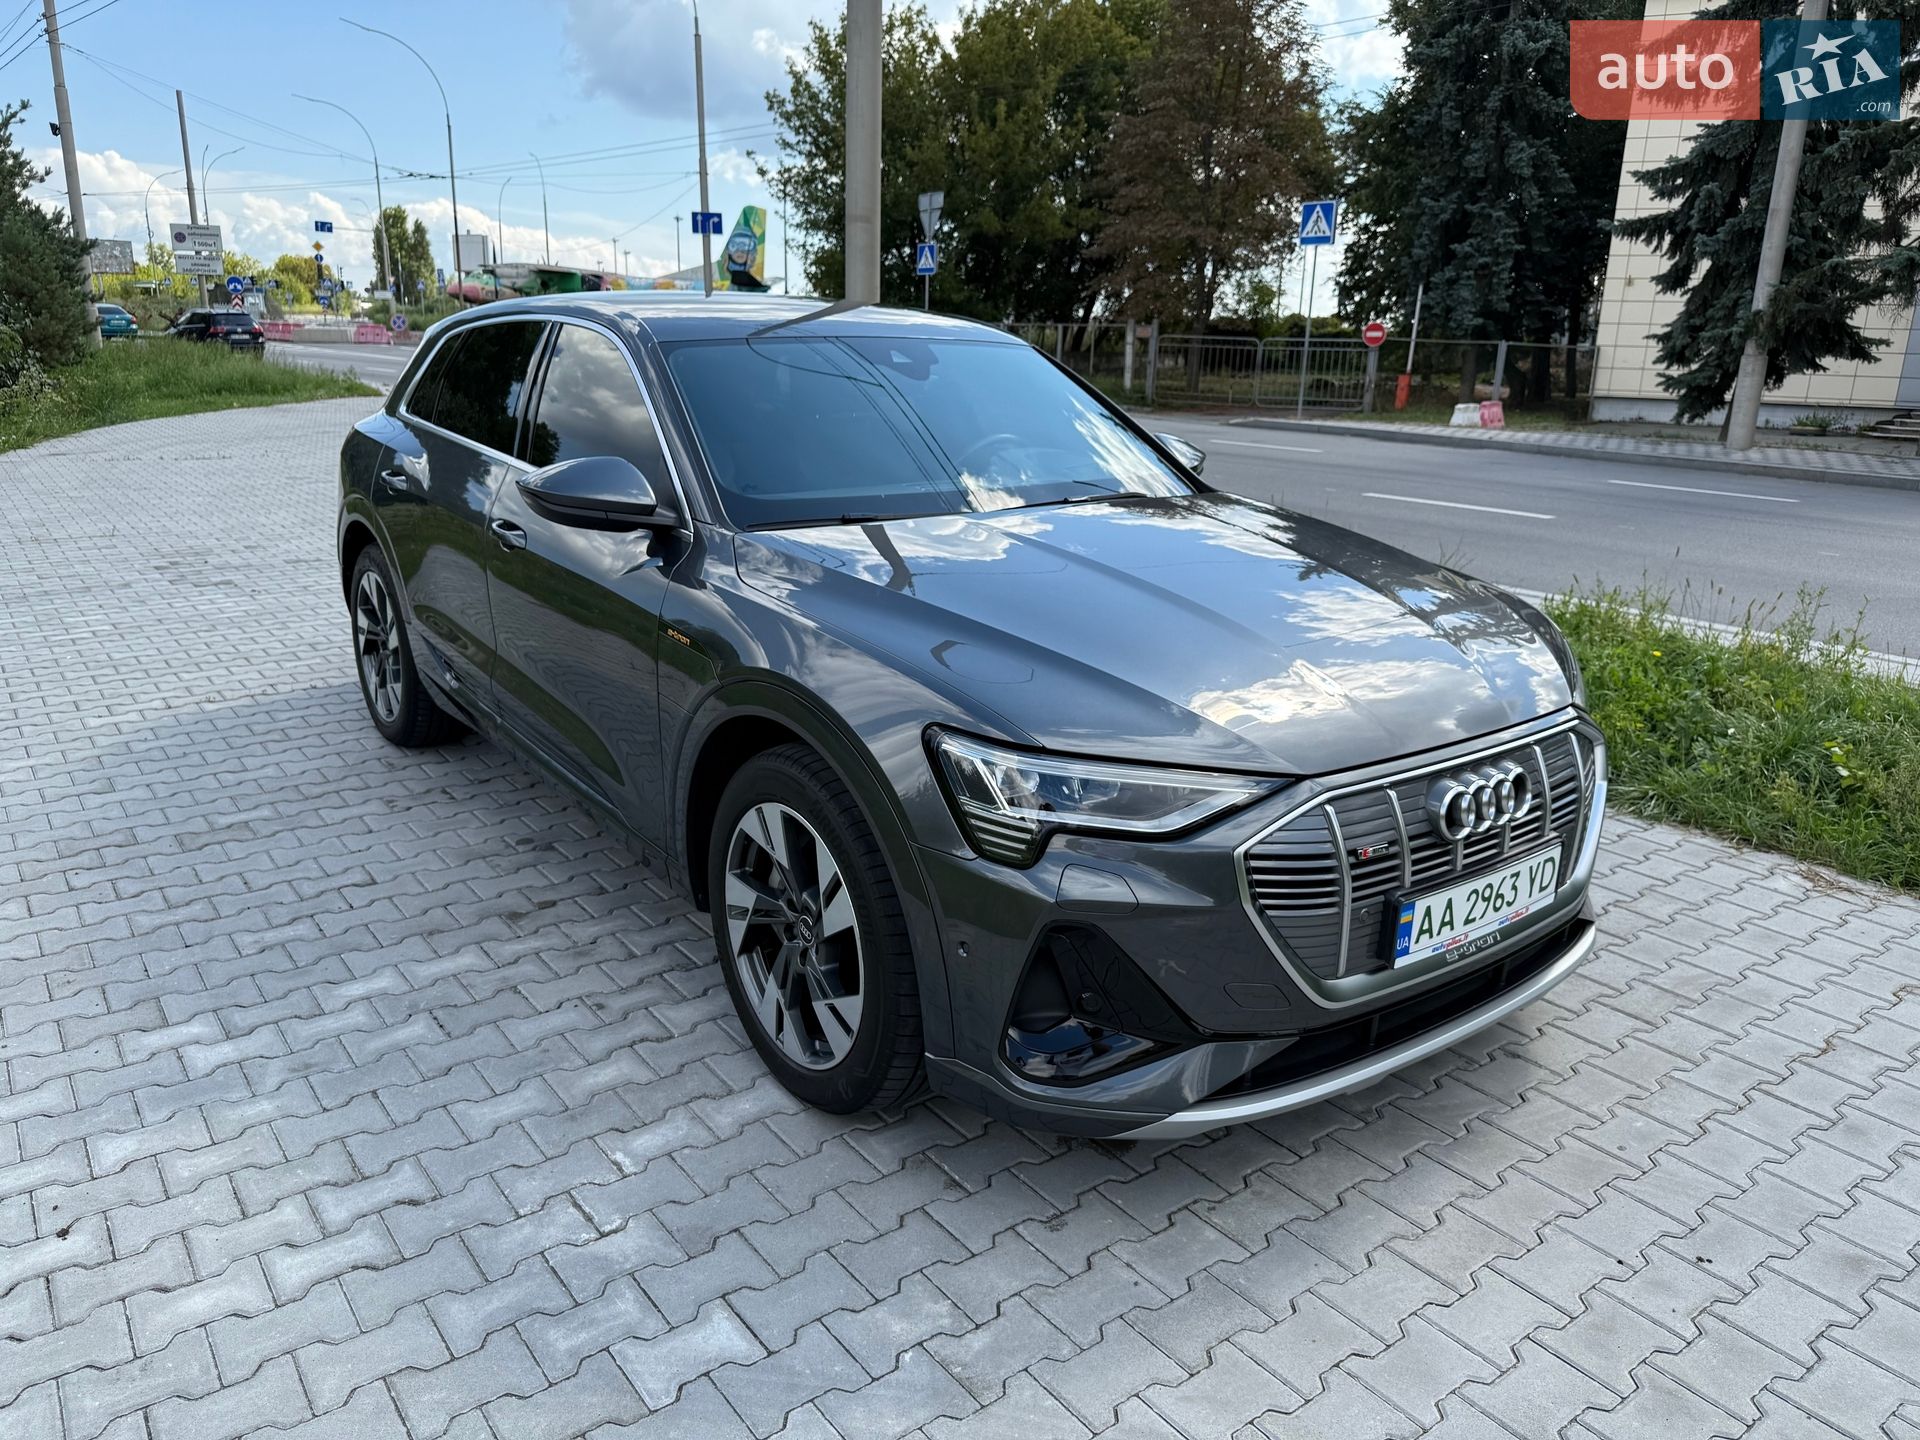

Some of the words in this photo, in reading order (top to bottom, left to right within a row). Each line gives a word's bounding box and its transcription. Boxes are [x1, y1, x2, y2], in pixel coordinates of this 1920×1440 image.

[1414, 897, 1455, 945] AA
[1463, 870, 1521, 927] 2963
[1528, 856, 1557, 899] YD
[1397, 936, 1410, 950] UA
